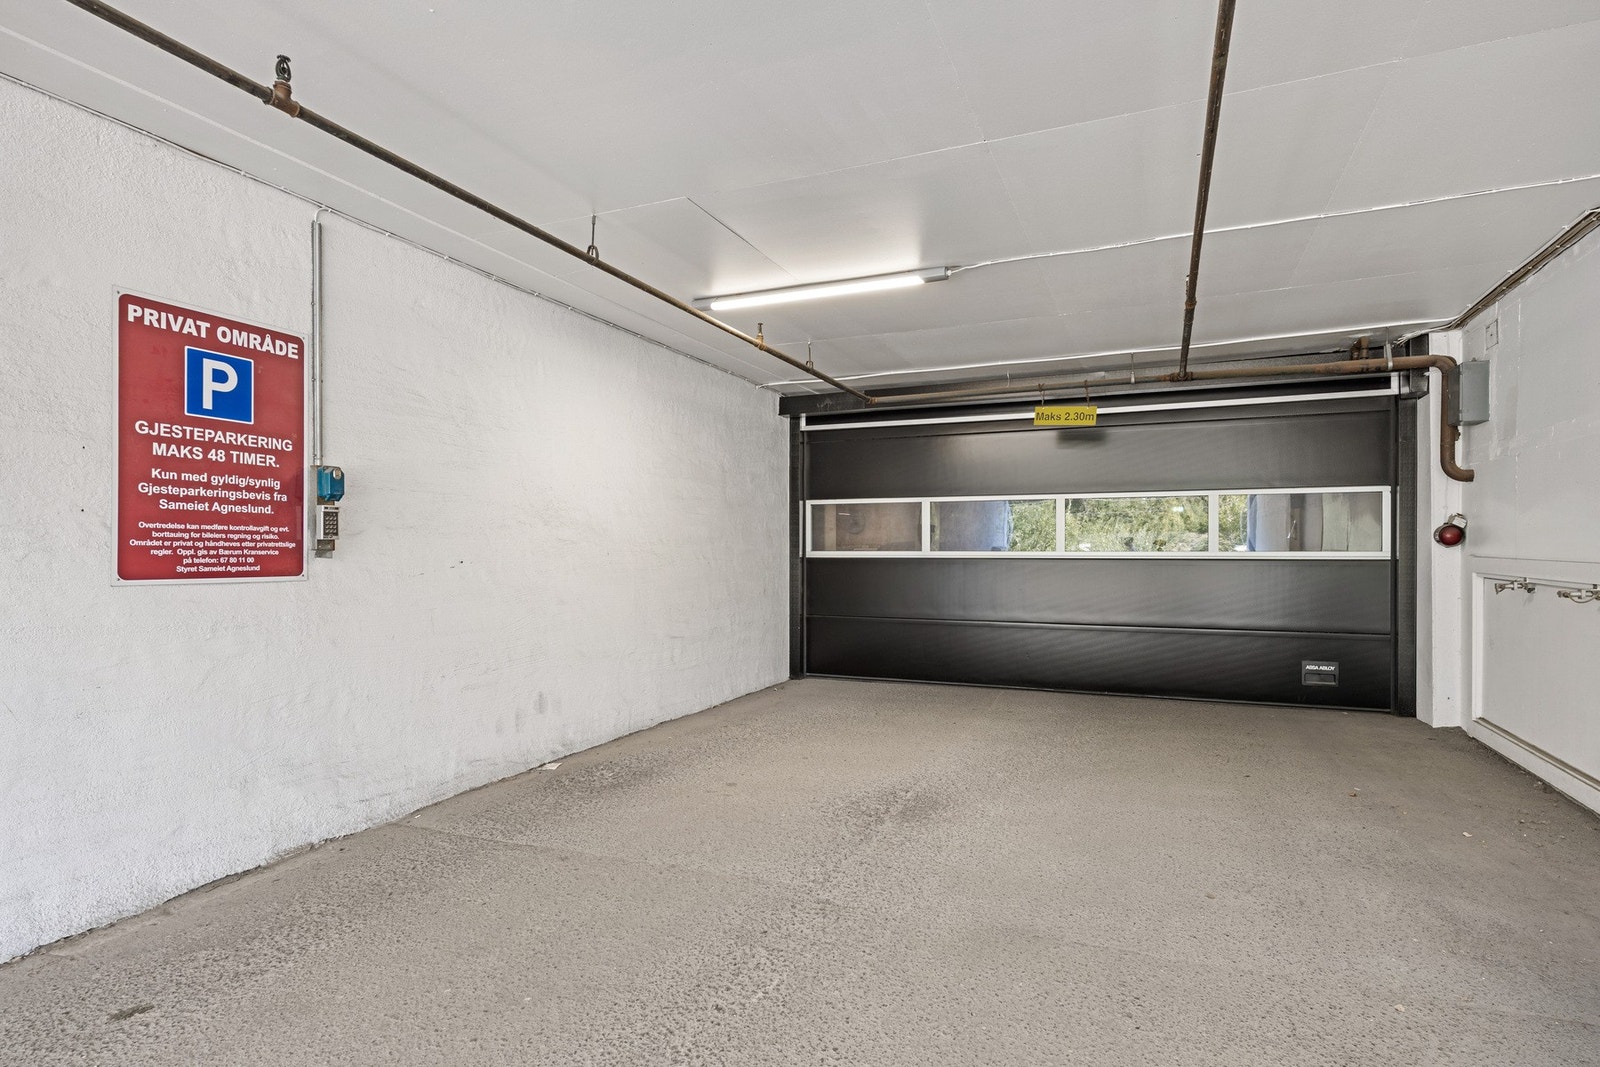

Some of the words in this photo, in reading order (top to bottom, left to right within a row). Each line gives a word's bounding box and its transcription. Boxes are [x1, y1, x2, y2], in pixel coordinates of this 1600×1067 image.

[127, 303, 210, 338] PRIVAT
[217, 325, 299, 359] OMRÅDE
[203, 358, 238, 410] P
[1036, 412, 1062, 421] Maks
[1064, 412, 1094, 421] 2.30m
[134, 420, 293, 451] GJESTEPARKERING
[152, 442, 203, 460] MAKS
[207, 449, 226, 462] 48
[230, 451, 280, 467] TIMER.
[151, 468, 177, 480] Kun
[181, 472, 207, 482] med
[210, 474, 281, 490] gyldig/synlig
[137, 482, 271, 501] Gjesteparkeringsbevis
[273, 493, 288, 502] fra
[159, 499, 209, 512] Sameiet
[211, 502, 274, 514] Agneslund.
[138, 521, 185, 530] Overtredelse
[229, 524, 269, 533] kontrollavgift
[176, 565, 197, 573] Styret
[226, 565, 260, 573] Agneslund
[183, 557, 192, 565] på
